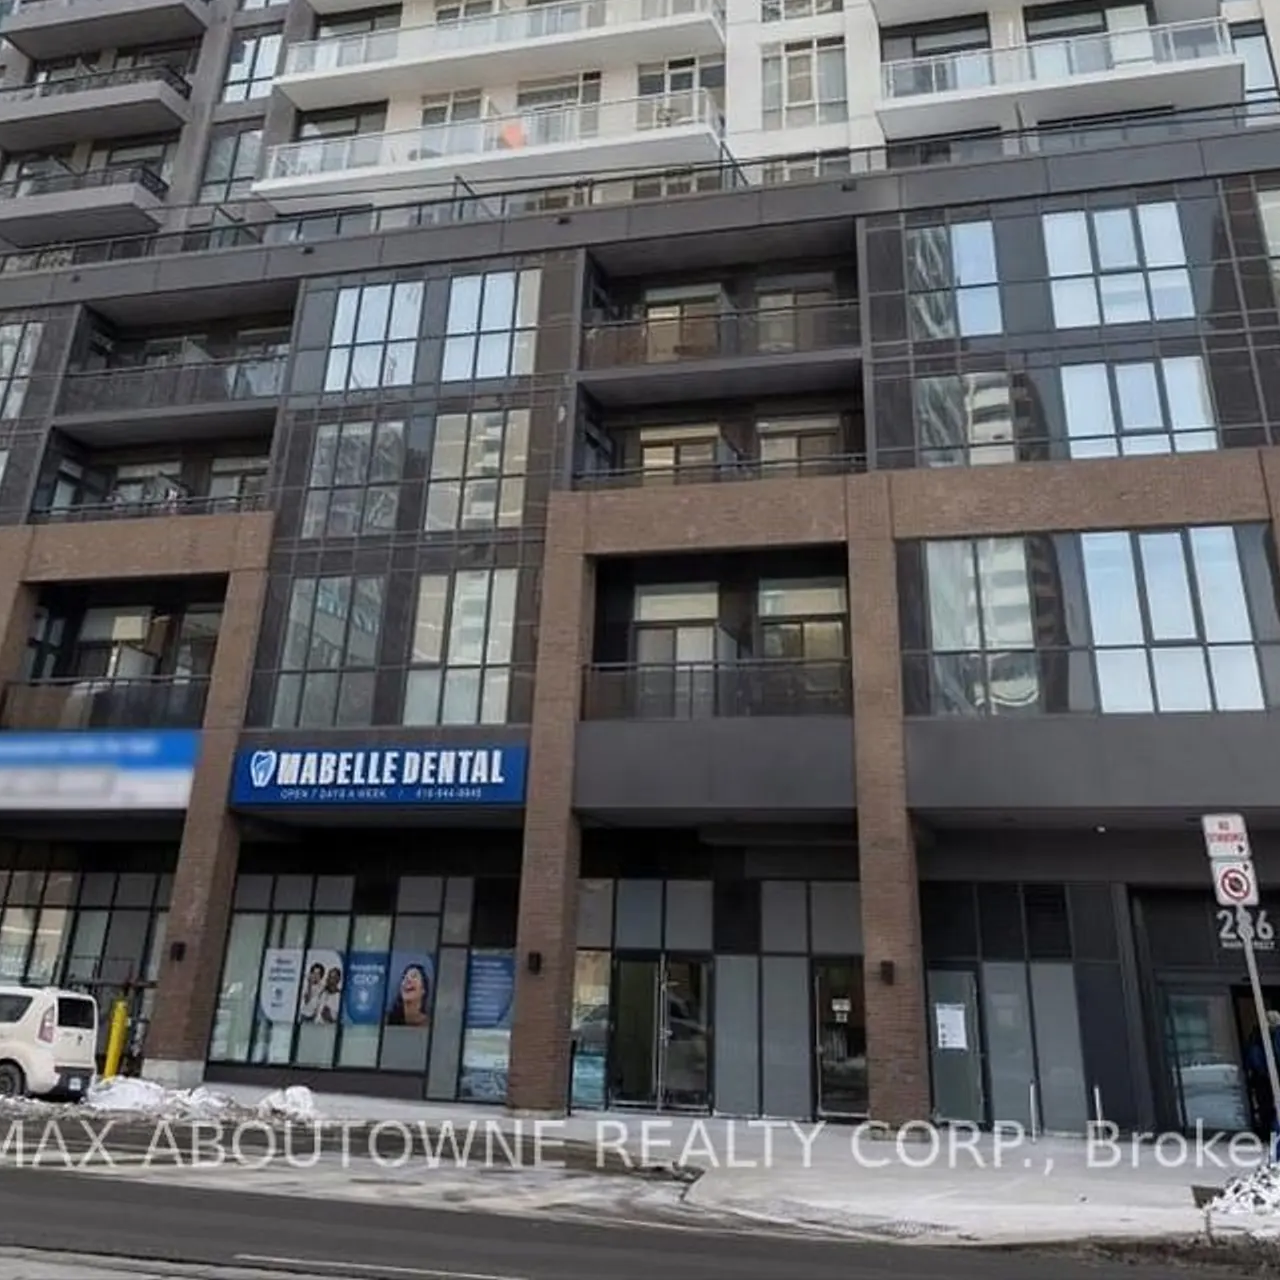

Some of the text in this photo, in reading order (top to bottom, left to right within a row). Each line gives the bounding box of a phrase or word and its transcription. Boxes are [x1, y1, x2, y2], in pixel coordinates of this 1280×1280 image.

[277, 750, 504, 785] MABELLE DENTAL
[280, 788, 308, 799] OPEN
